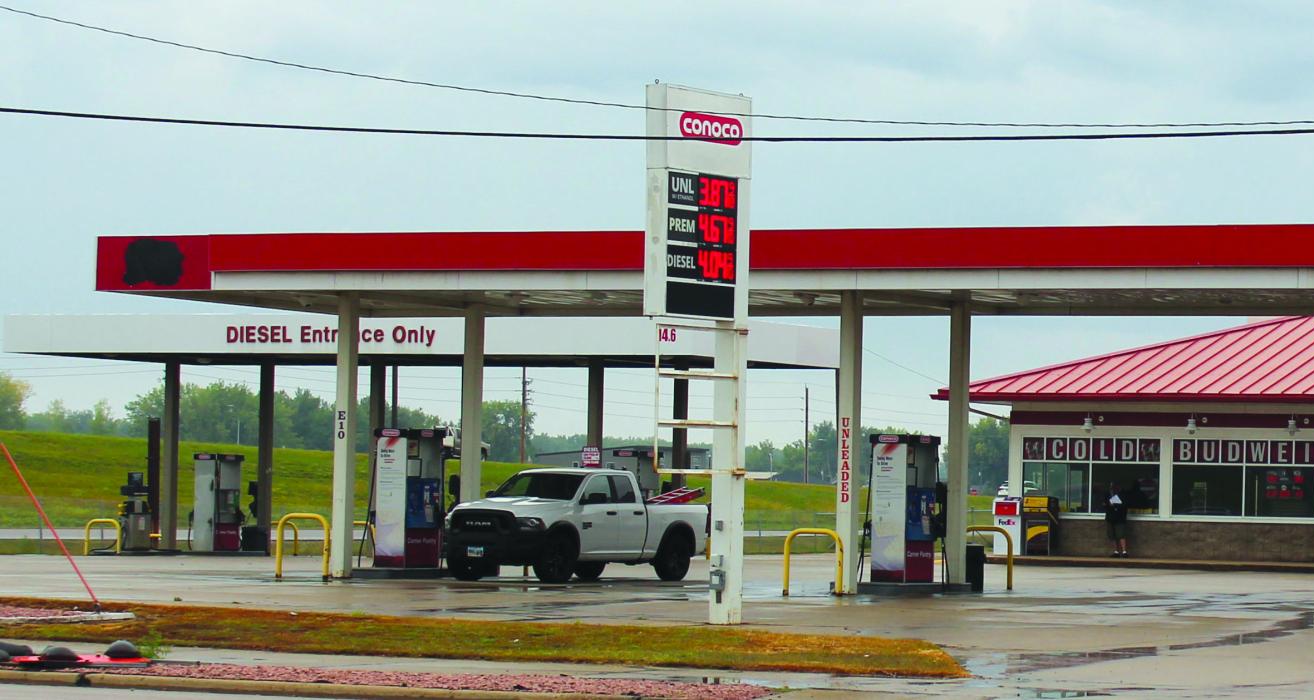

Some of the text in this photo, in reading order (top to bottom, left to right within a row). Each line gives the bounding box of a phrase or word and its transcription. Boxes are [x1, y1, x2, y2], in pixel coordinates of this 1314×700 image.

[671, 176, 695, 194] UNL
[669, 217, 696, 233] PREM
[667, 254, 696, 269] DIESEL
[226, 326, 436, 347] DIESEL Entrce Only
[337, 410, 346, 440] E10
[1052, 439, 1133, 460] COLD
[841, 417, 850, 503] UNLEADED
[998, 518, 1016, 526] FedEx
